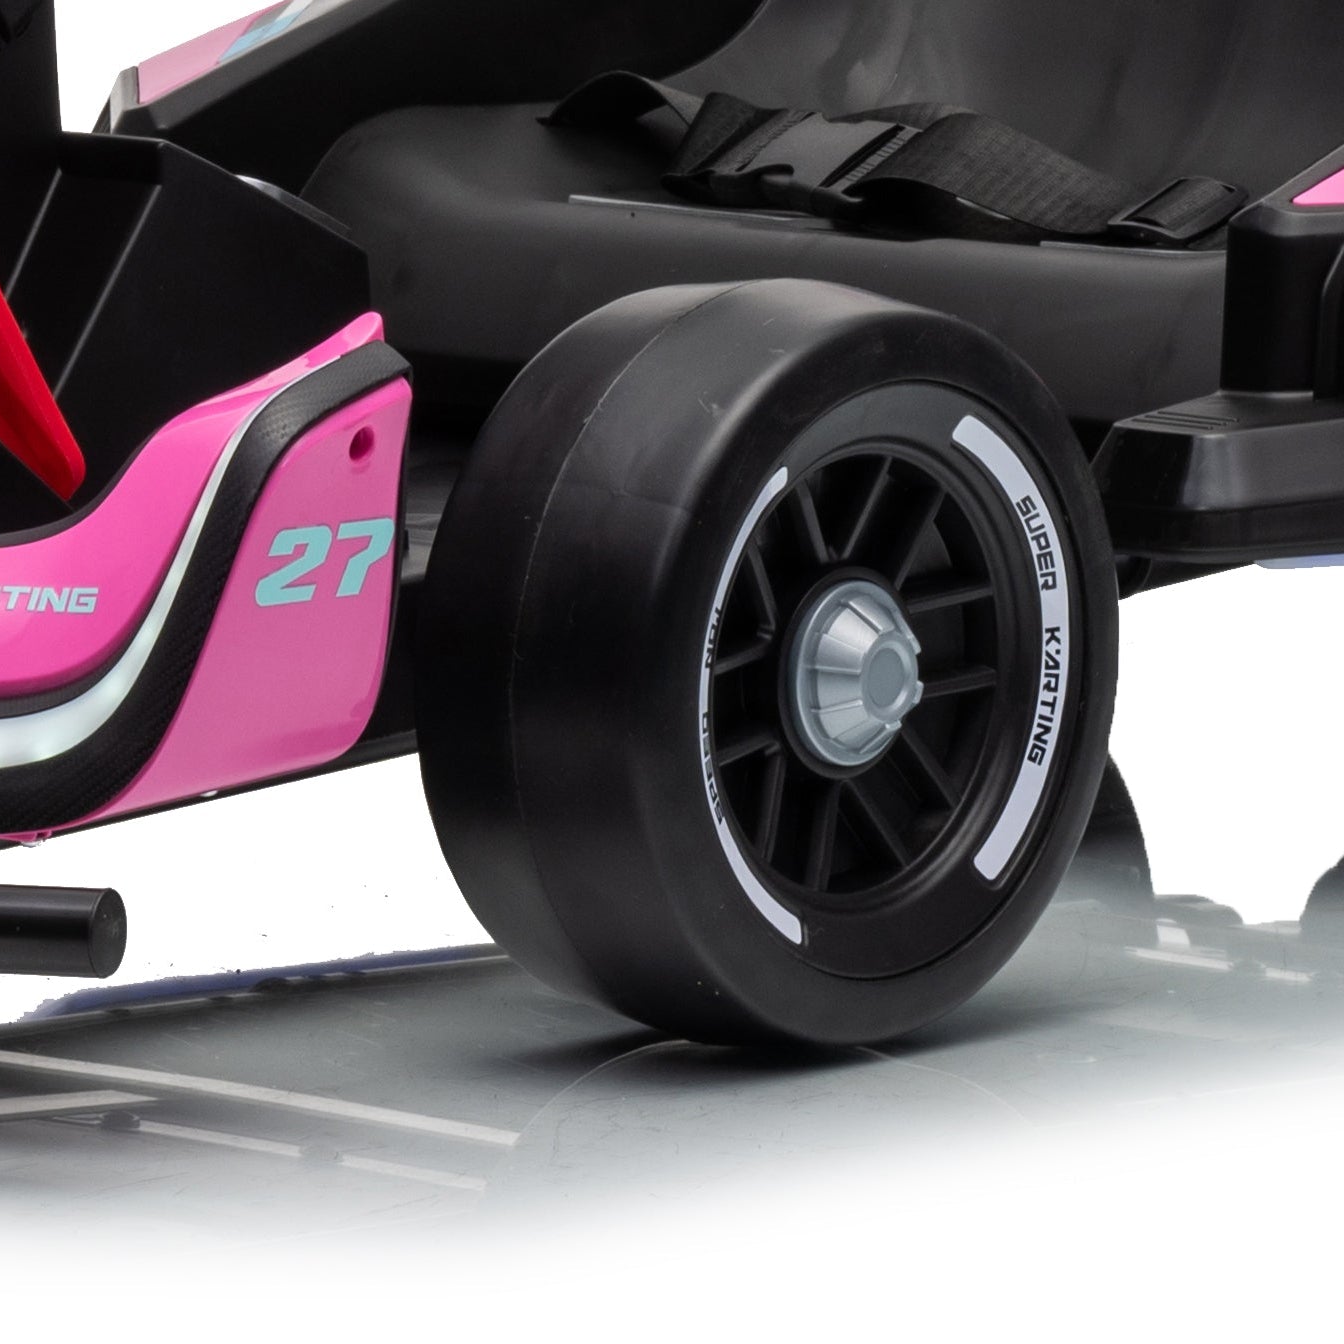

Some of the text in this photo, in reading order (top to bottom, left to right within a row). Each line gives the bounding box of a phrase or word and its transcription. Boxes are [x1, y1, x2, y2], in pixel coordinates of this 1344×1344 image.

[255, 517, 395, 608] 27
[1015, 495, 1062, 767] SUPER K'ARTING
